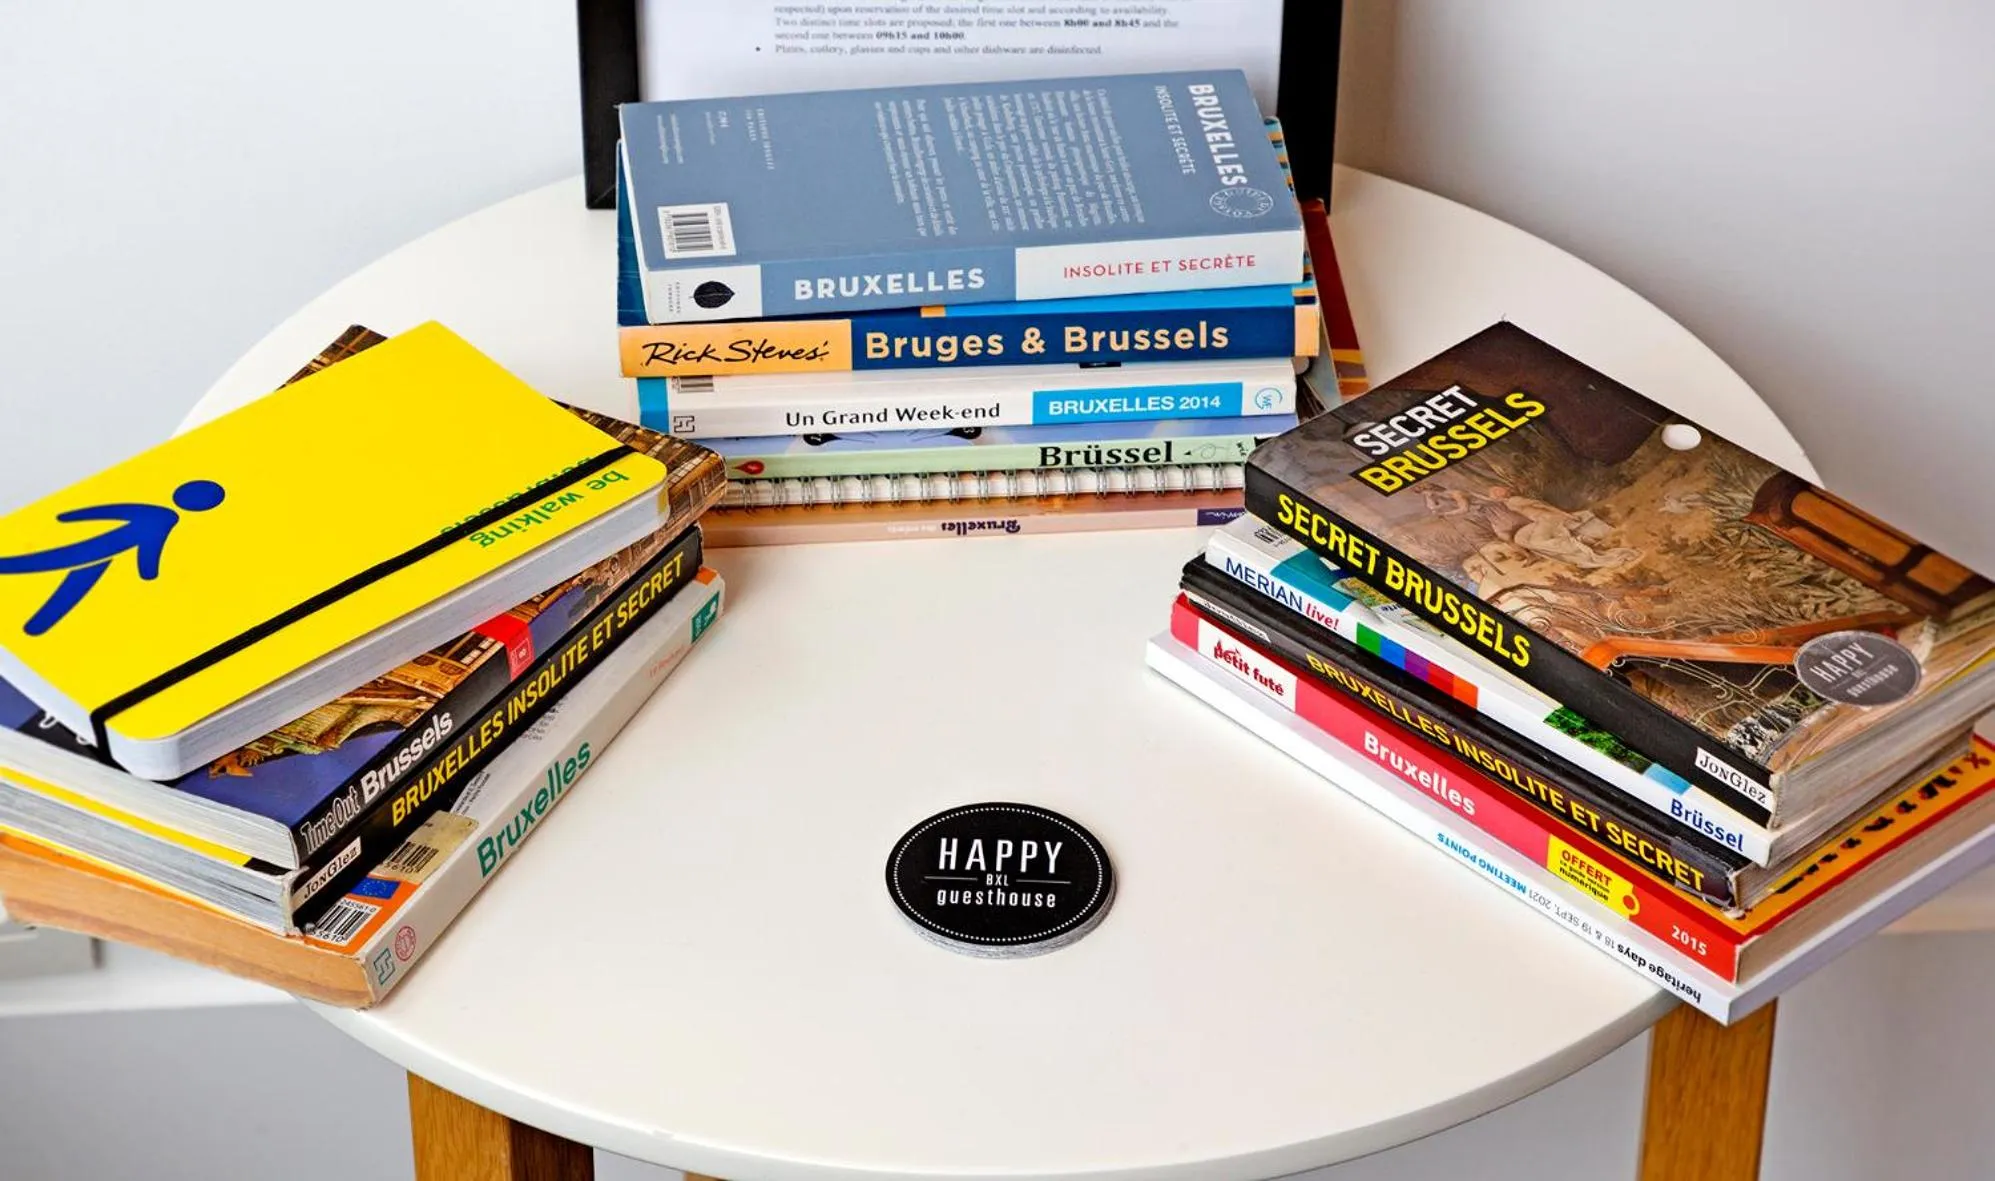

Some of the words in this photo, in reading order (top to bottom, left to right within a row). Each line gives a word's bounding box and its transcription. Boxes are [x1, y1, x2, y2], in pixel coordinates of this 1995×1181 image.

[775, 18, 797, 27] Two
[957, 18, 973, 27] the
[1064, 18, 1089, 27] 8h00
[1092, 18, 1111, 27] and
[1114, 18, 1141, 27] 8h45
[1143, 19, 1161, 27] and
[1164, 19, 1179, 27] the
[855, 5, 909, 13] reservation
[912, 4, 927, 13] of
[930, 5, 941, 13] the
[1006, 5, 1025, 13] slot
[1028, 5, 1046, 13] and
[1048, 5, 1097, 15] according
[875, 31, 907, 40] 09h15
[910, 31, 930, 40] and
[1154, 85, 1178, 122] INSOLITE
[1167, 122, 1183, 135] ET
[1188, 84, 1248, 186] BRUXELLES
[1171, 136, 1196, 175] SECRÈTE
[1064, 262, 1144, 279] INSOLITE
[1151, 259, 1171, 273] ET
[1178, 254, 1257, 271] SECRÈTE
[794, 268, 985, 301] BRUXELLES
[640, 340, 722, 367] Rick
[866, 331, 1004, 362] Bruges
[1021, 326, 1046, 355] &
[1064, 320, 1230, 353] Brussels
[785, 412, 816, 428] Un
[822, 407, 888, 427] Grand
[895, 402, 1001, 423] Week-end
[1048, 396, 1175, 416] BRUXELLES
[1179, 395, 1221, 410] 2014
[1352, 384, 1478, 457] SECRET
[1039, 440, 1173, 468] Brüssel
[1359, 391, 1546, 493] BRUSSELS
[586, 470, 631, 492] be
[469, 493, 585, 549] walking
[942, 518, 1021, 536] Bruxelles
[1225, 557, 1302, 615] MERIAN
[1305, 602, 1341, 631] live!
[1277, 493, 1381, 577] SECRET
[1385, 559, 1531, 669] BRUSSELS
[1213, 640, 1251, 675] petit
[1252, 665, 1285, 697] futé
[1809, 641, 1876, 684] HAPPY
[391, 710, 505, 827] BRUXELLES
[508, 635, 589, 725] INSOLITE
[592, 620, 613, 651] ET
[617, 552, 685, 629] SECRET
[360, 711, 453, 803] Brussels
[1305, 652, 1451, 745] BRUXELLES
[1454, 731, 1566, 814] INSOLITE
[1571, 802, 1602, 832] ET
[1604, 820, 1704, 892] SECRET
[1363, 731, 1477, 817] Bruxelles
[476, 741, 591, 878] Bruxelles
[1670, 798, 1745, 853] Brüssel
[938, 837, 1063, 874] HAPPY
[1437, 832, 1477, 865] POINTS
[986, 873, 1009, 887] BXL
[1477, 858, 1527, 895] MEETING
[1561, 849, 1613, 887] OFFERT
[937, 888, 1056, 908] guesthouse
[1529, 889, 1552, 909] 2021
[1581, 920, 1592, 933] 19
[1594, 929, 1604, 940] &
[1604, 935, 1616, 949] 18
[1671, 925, 1707, 956] 2015
[1616, 942, 1647, 968] days
[1648, 961, 1702, 1003] heritage
